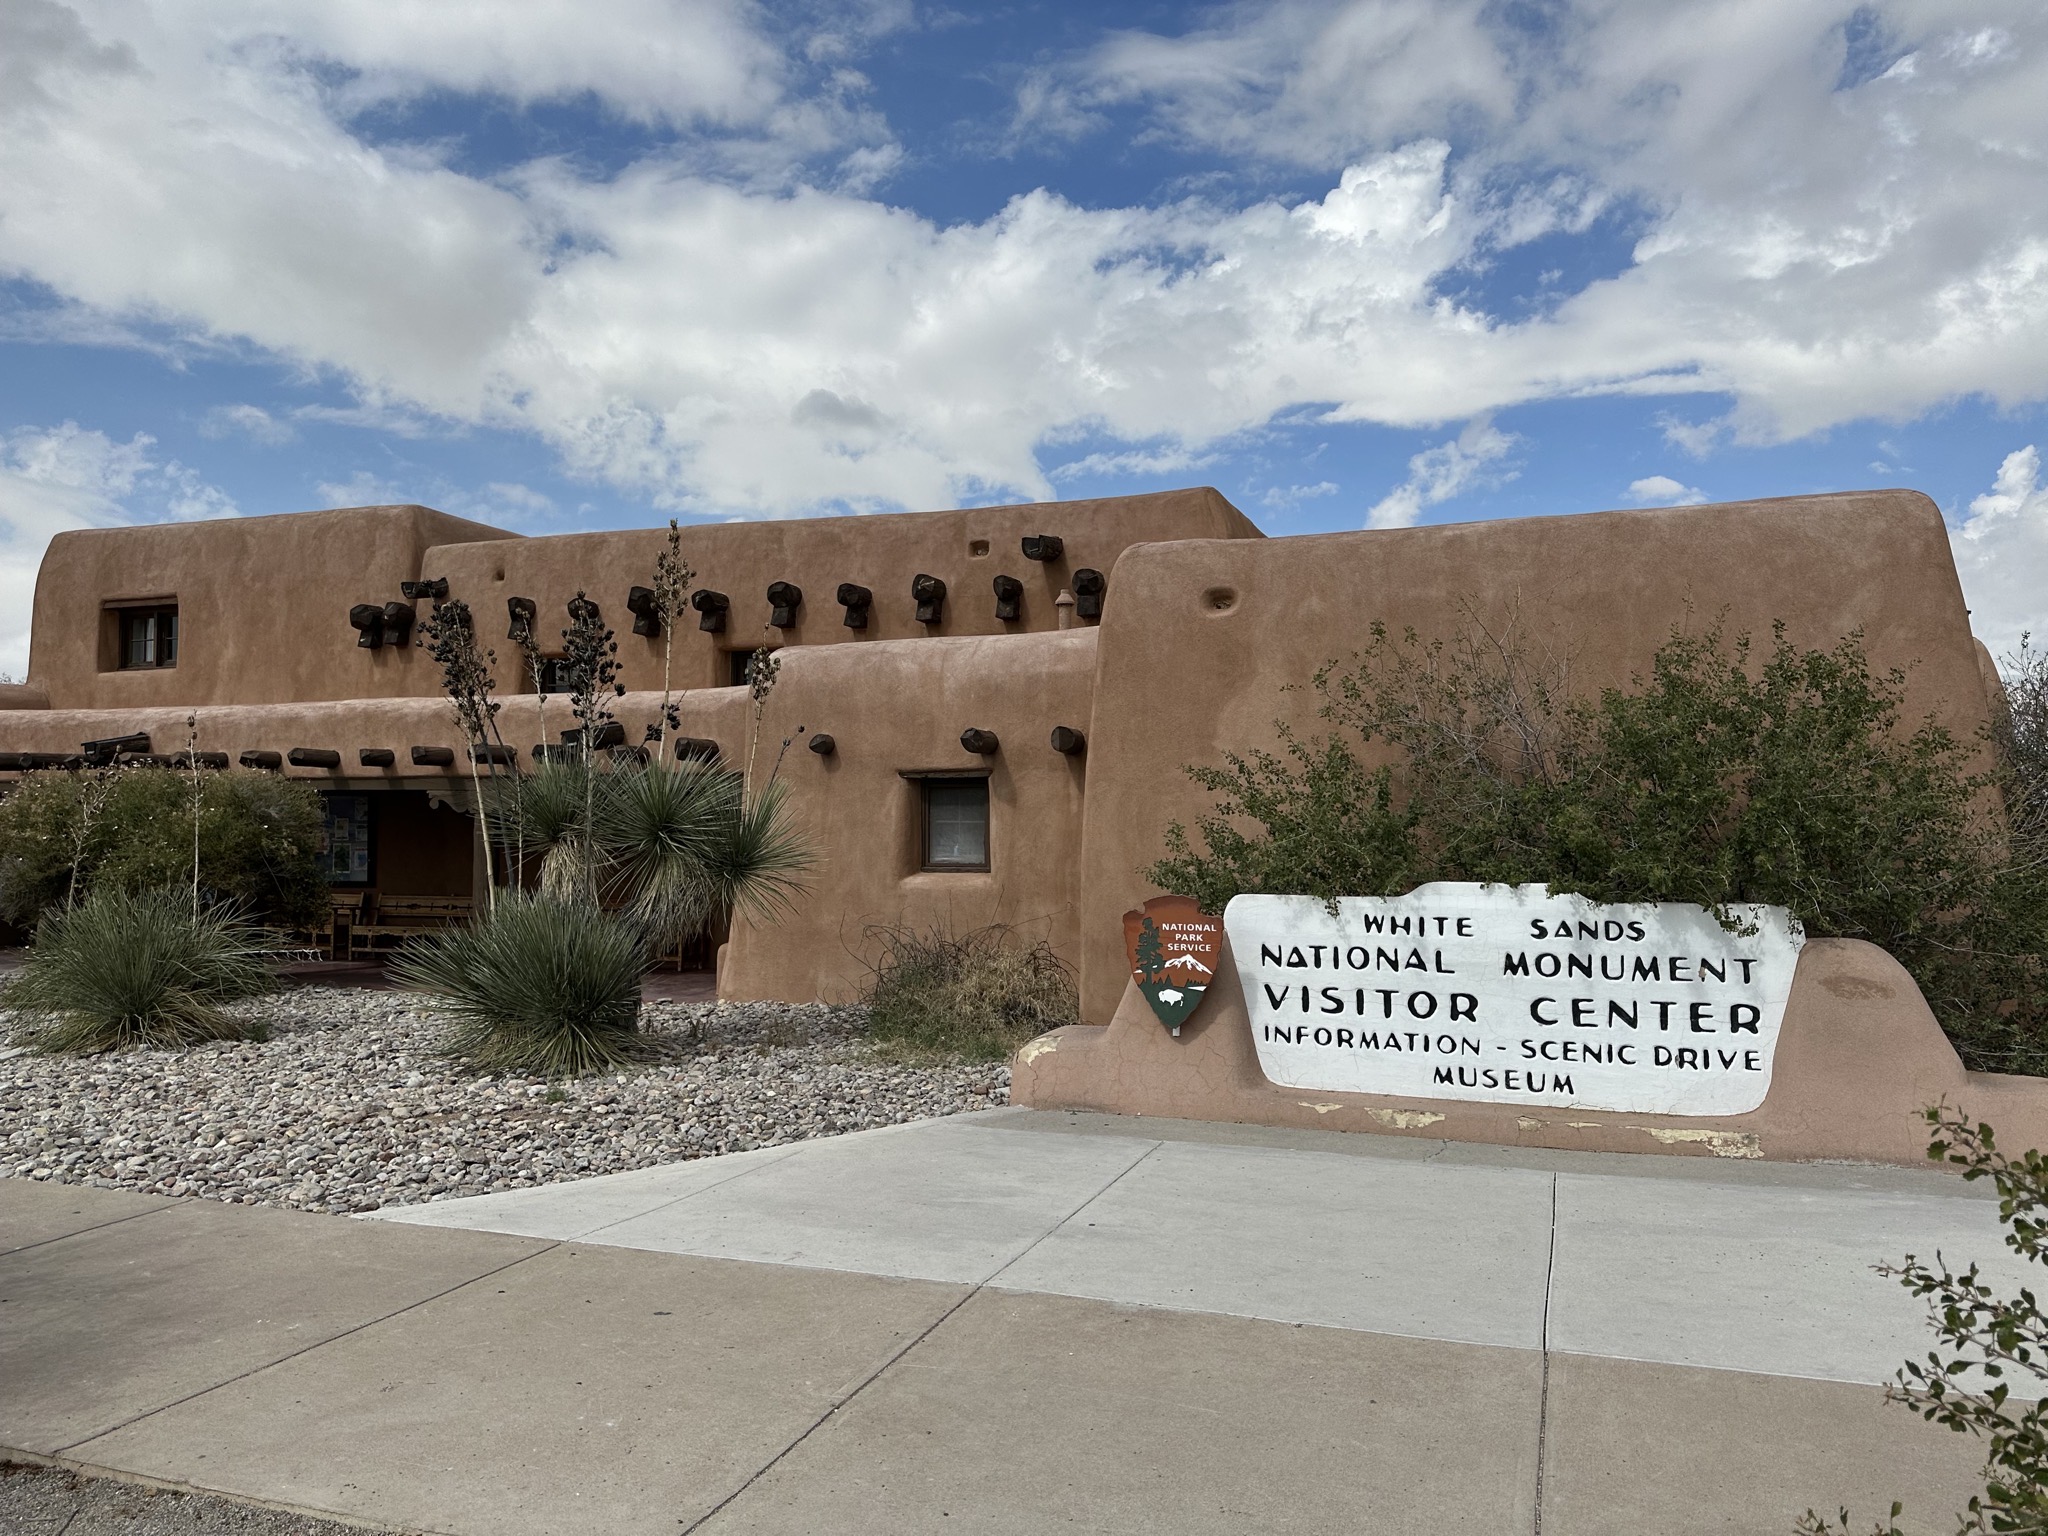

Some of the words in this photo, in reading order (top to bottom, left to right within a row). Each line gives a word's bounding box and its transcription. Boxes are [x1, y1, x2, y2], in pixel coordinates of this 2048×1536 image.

[1162, 923, 1217, 932] NATIONAL
[1175, 933, 1204, 942] PARK
[1363, 913, 1474, 938] WHITE
[1530, 918, 1646, 942] SANDS
[1167, 943, 1212, 952] SERVICE
[1261, 943, 1456, 974] NATIONAL
[1503, 951, 1758, 985] MONUMENT
[1263, 983, 1479, 1023] VISITOR
[1529, 997, 1761, 1035] CENTER
[1264, 1025, 1481, 1056] INFORMATION
[1521, 1039, 1636, 1065] SCENIC
[1653, 1045, 1762, 1071] DRIVE
[1433, 1066, 1575, 1095] MUSEUM
